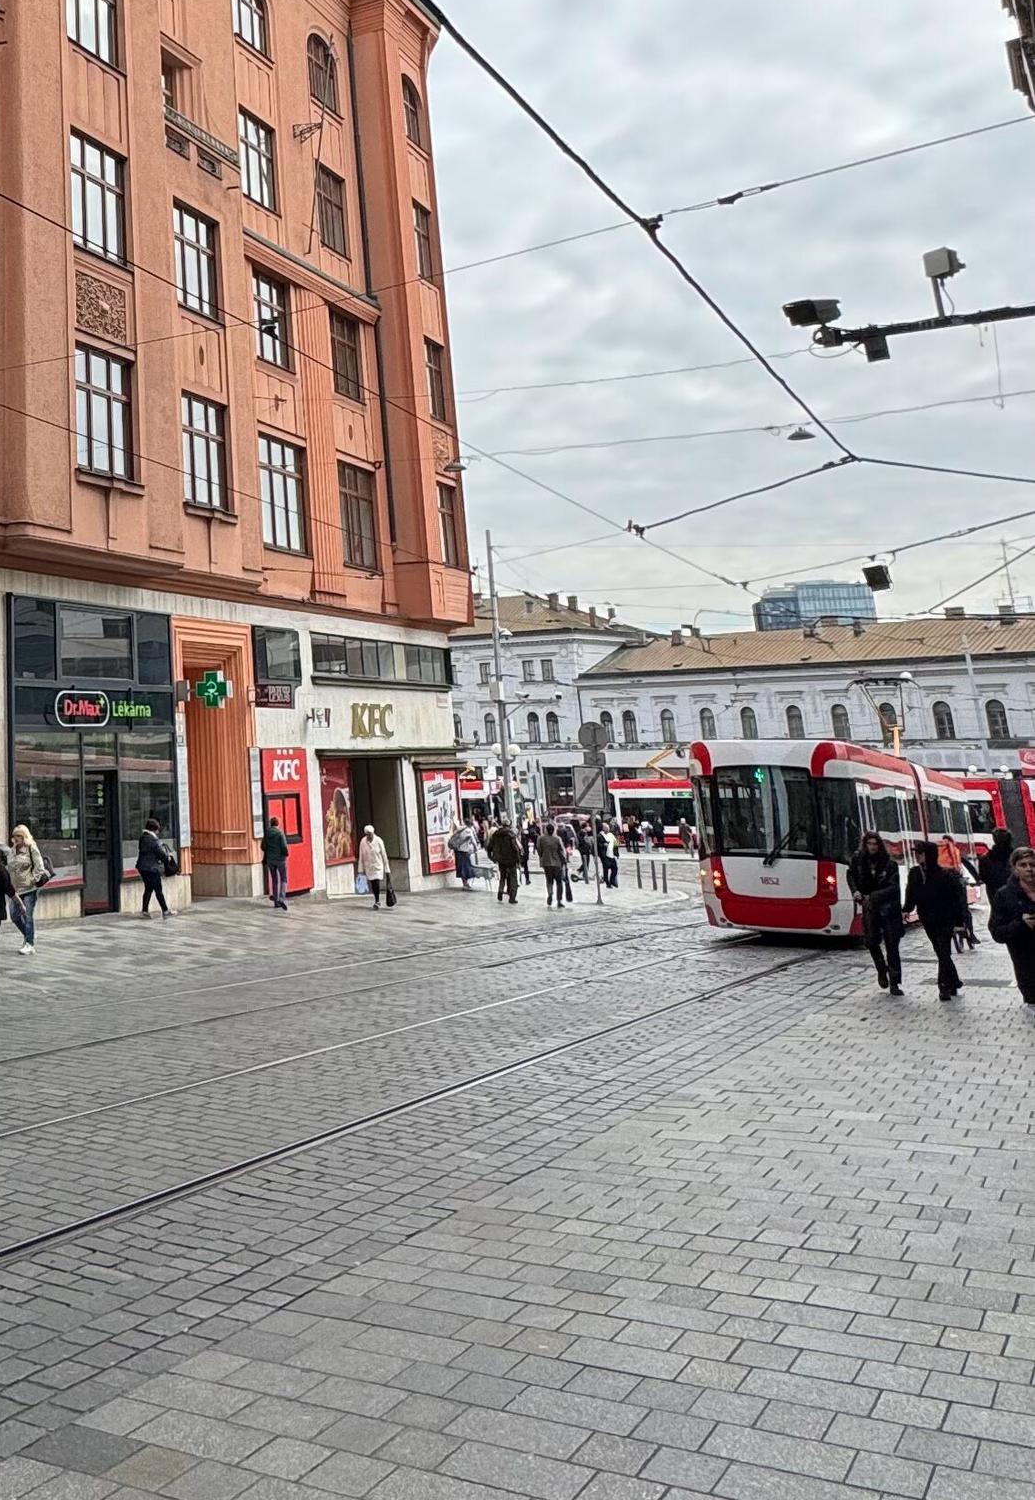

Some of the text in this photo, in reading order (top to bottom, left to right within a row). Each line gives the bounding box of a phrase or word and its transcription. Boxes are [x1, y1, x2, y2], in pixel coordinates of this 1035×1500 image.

[63, 699, 151, 717] Dr.Max Lékárna
[350, 702, 395, 739] KFC
[272, 758, 301, 782] KFC
